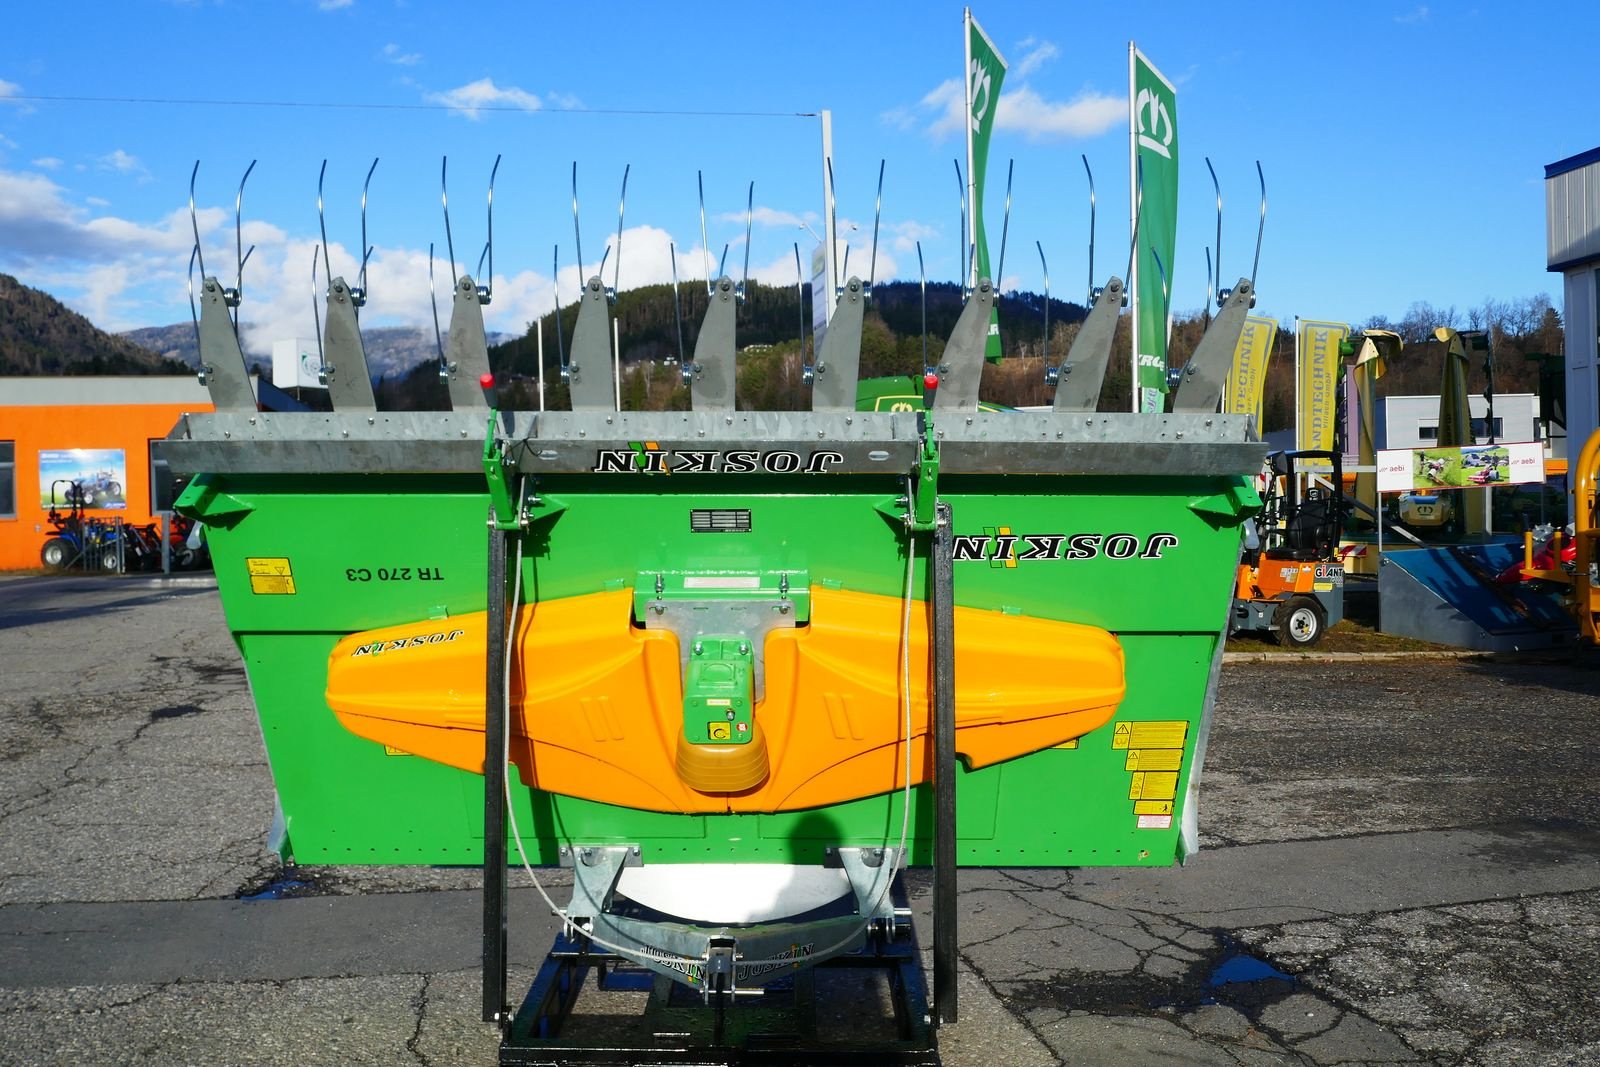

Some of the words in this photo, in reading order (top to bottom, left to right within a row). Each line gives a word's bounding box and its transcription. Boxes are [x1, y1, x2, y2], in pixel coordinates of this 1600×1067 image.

[1322, 400, 1331, 429] Villach
[593, 449, 844, 475] JOSKIN
[1389, 464, 1405, 472] aebi
[1521, 457, 1536, 465] aebi
[952, 533, 1178, 562] JOSKIN
[345, 566, 372, 581] C3
[377, 567, 411, 582] 270
[416, 567, 444, 582] TR
[352, 629, 464, 657] JOSKIN
[737, 943, 815, 981] JOSKIN
